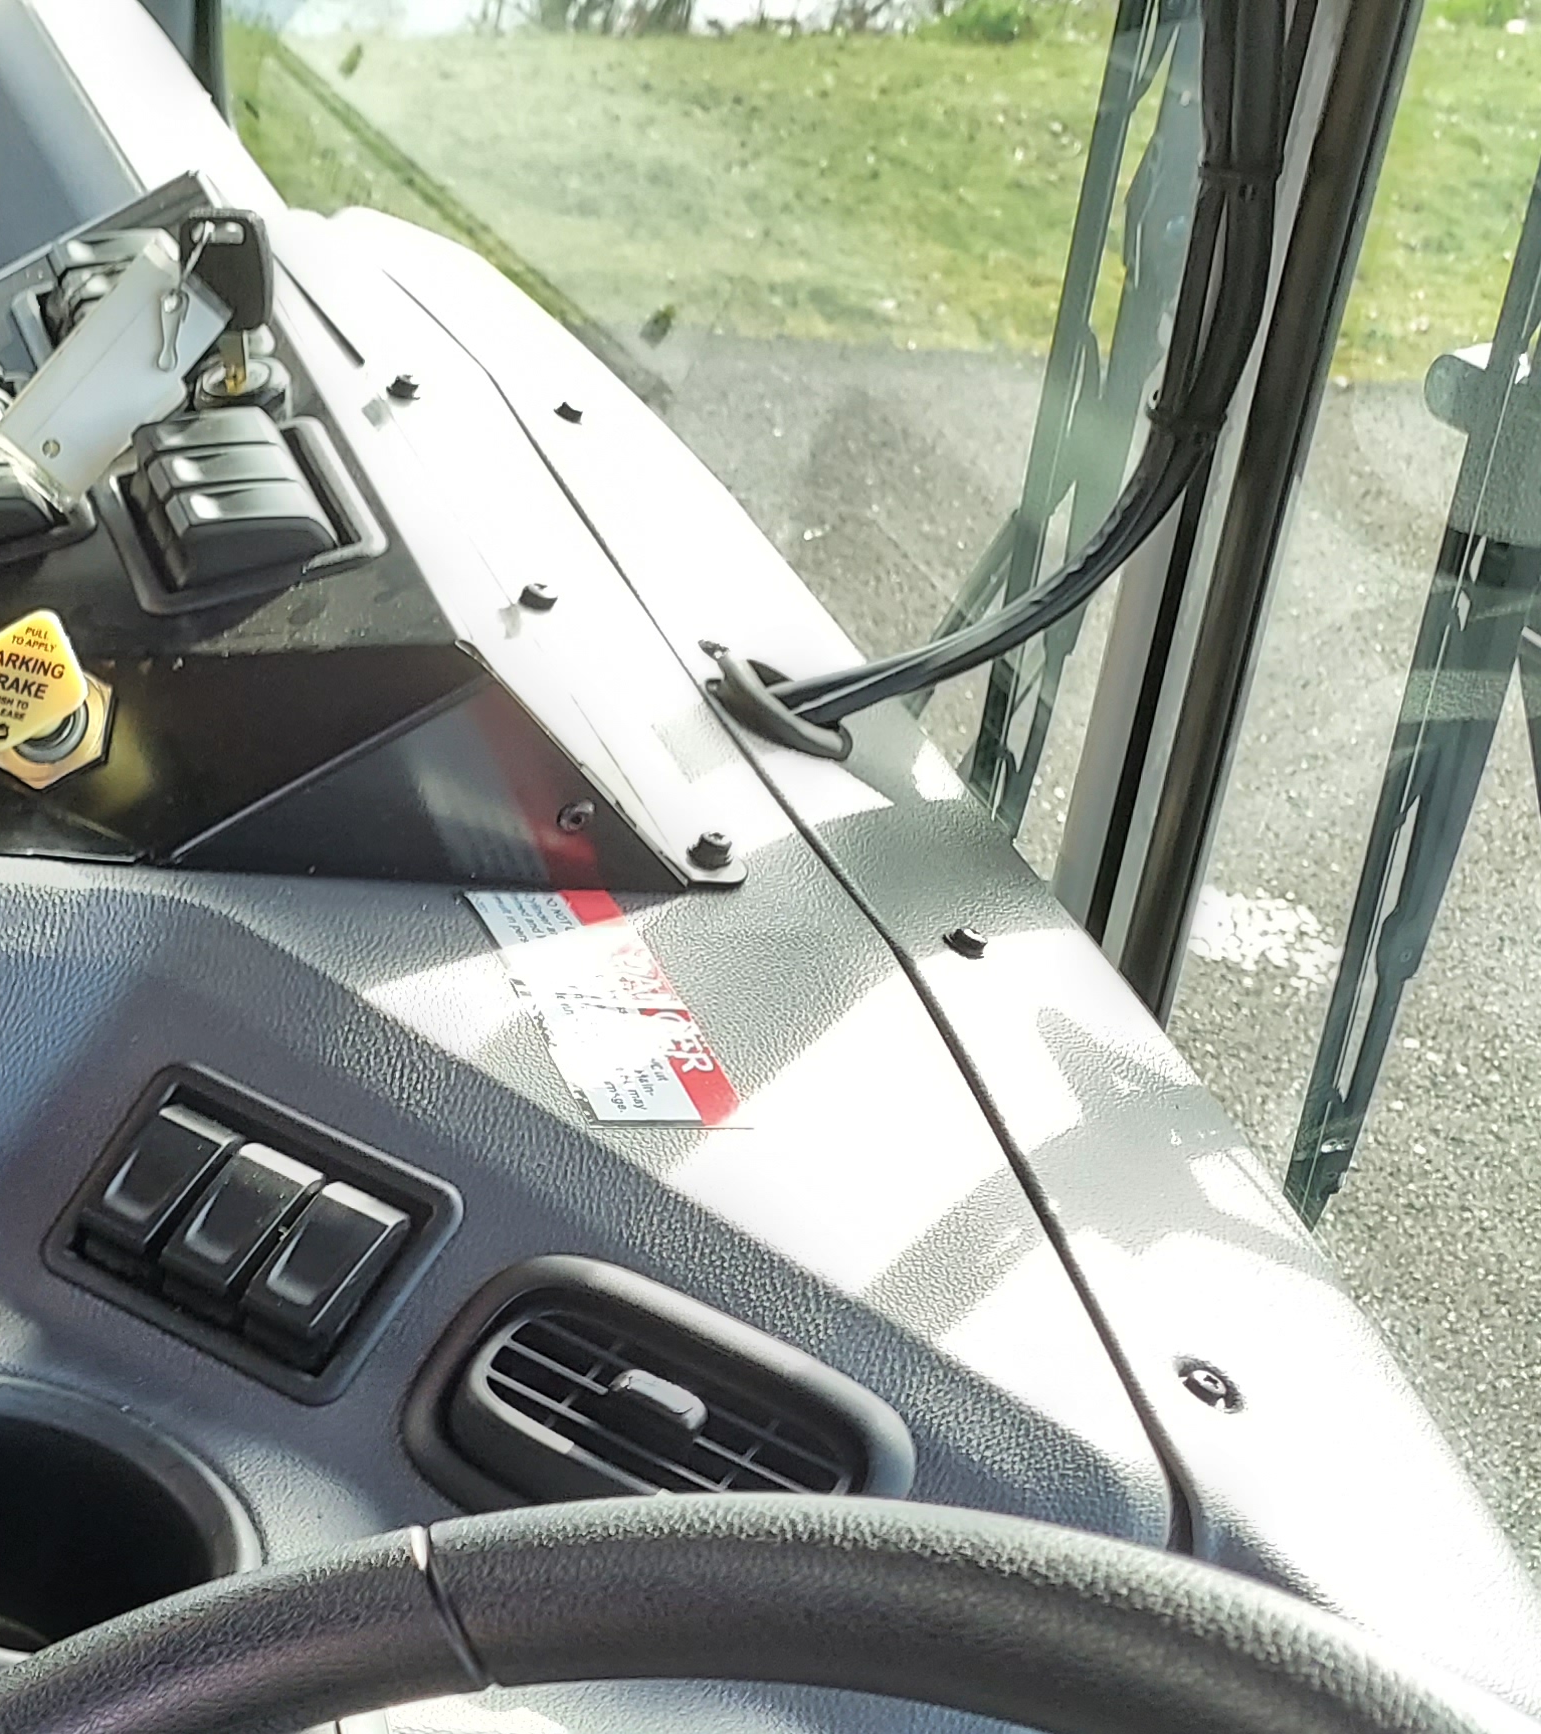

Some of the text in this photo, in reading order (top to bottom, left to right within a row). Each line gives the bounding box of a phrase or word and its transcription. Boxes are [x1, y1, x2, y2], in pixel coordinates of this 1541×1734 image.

[25, 626, 48, 640] PULL
[11, 634, 57, 653] TO APPLY
[17, 699, 29, 711] TO
